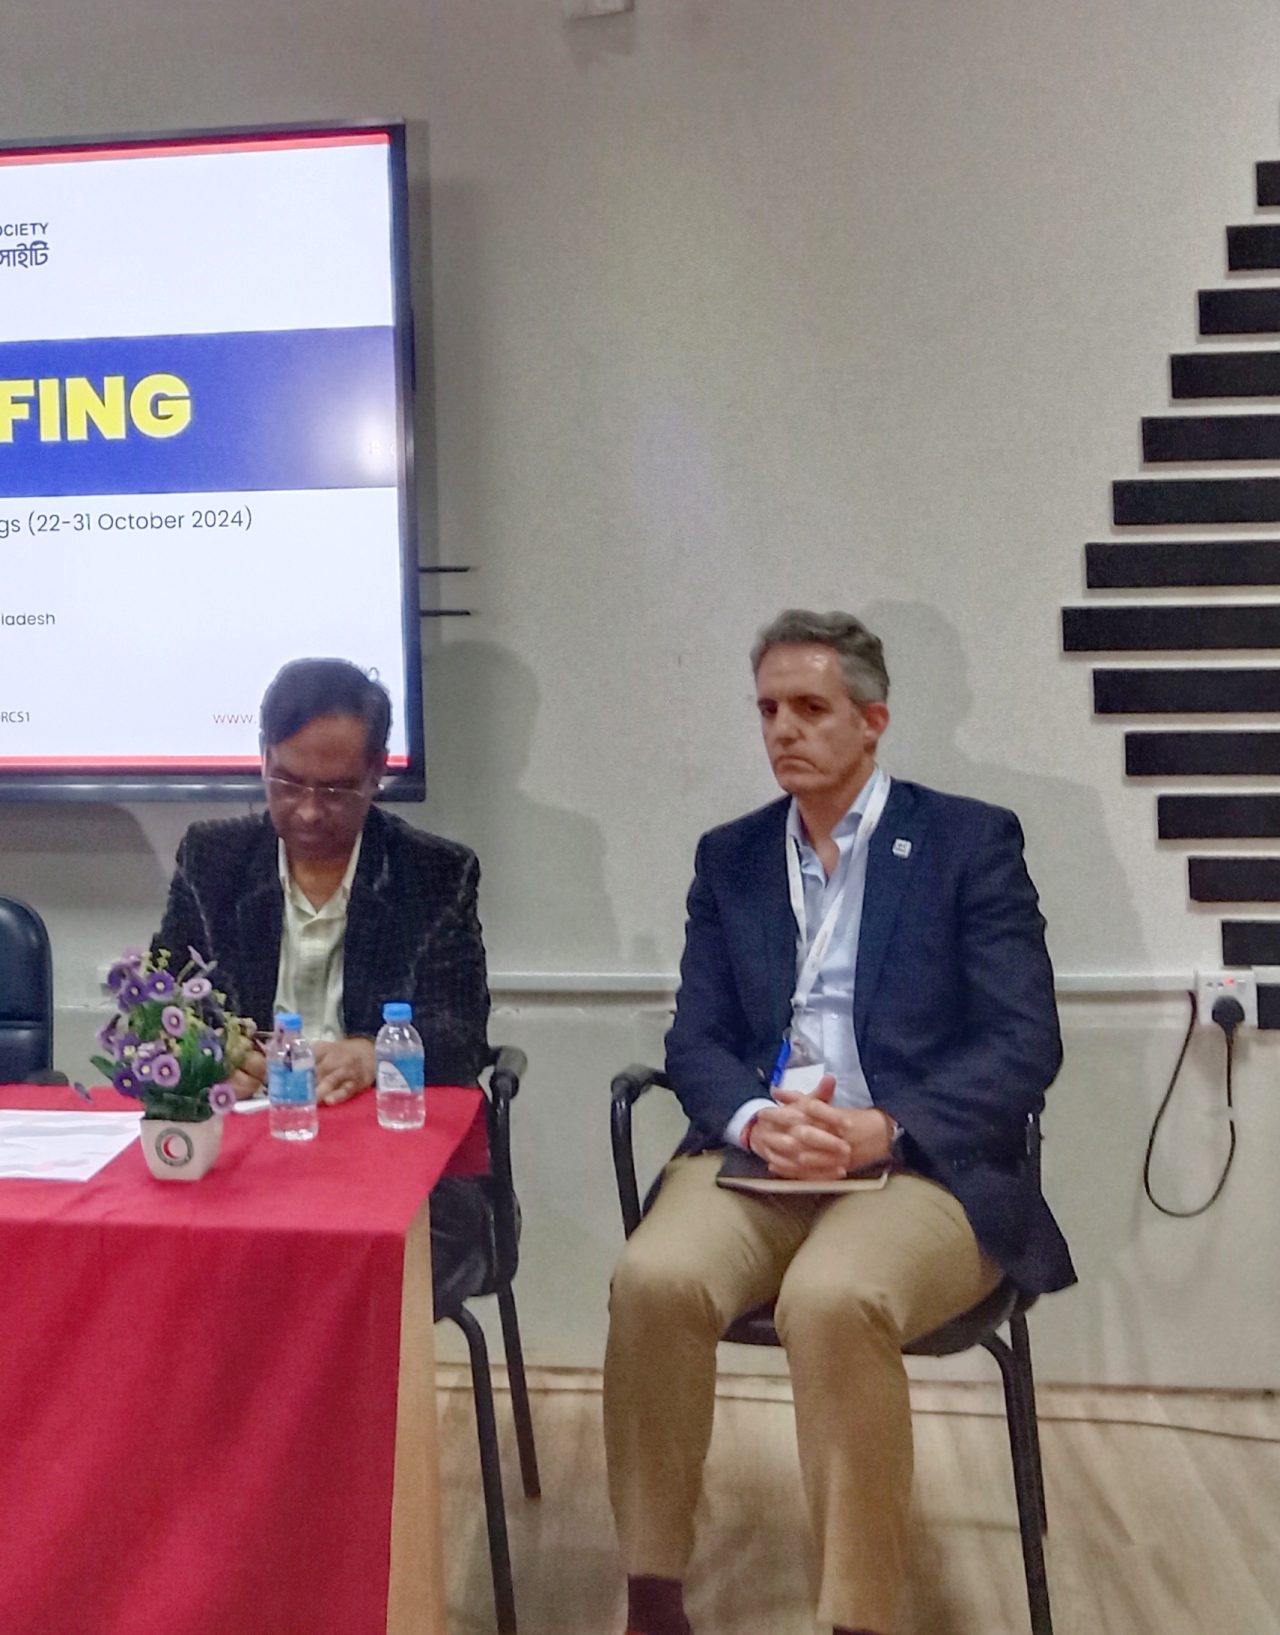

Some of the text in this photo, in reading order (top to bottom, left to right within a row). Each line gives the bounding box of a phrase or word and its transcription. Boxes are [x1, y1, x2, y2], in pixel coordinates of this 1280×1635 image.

[28, 510, 91, 537] (22-31
[97, 511, 185, 531] October
[191, 505, 252, 531] 2024)
